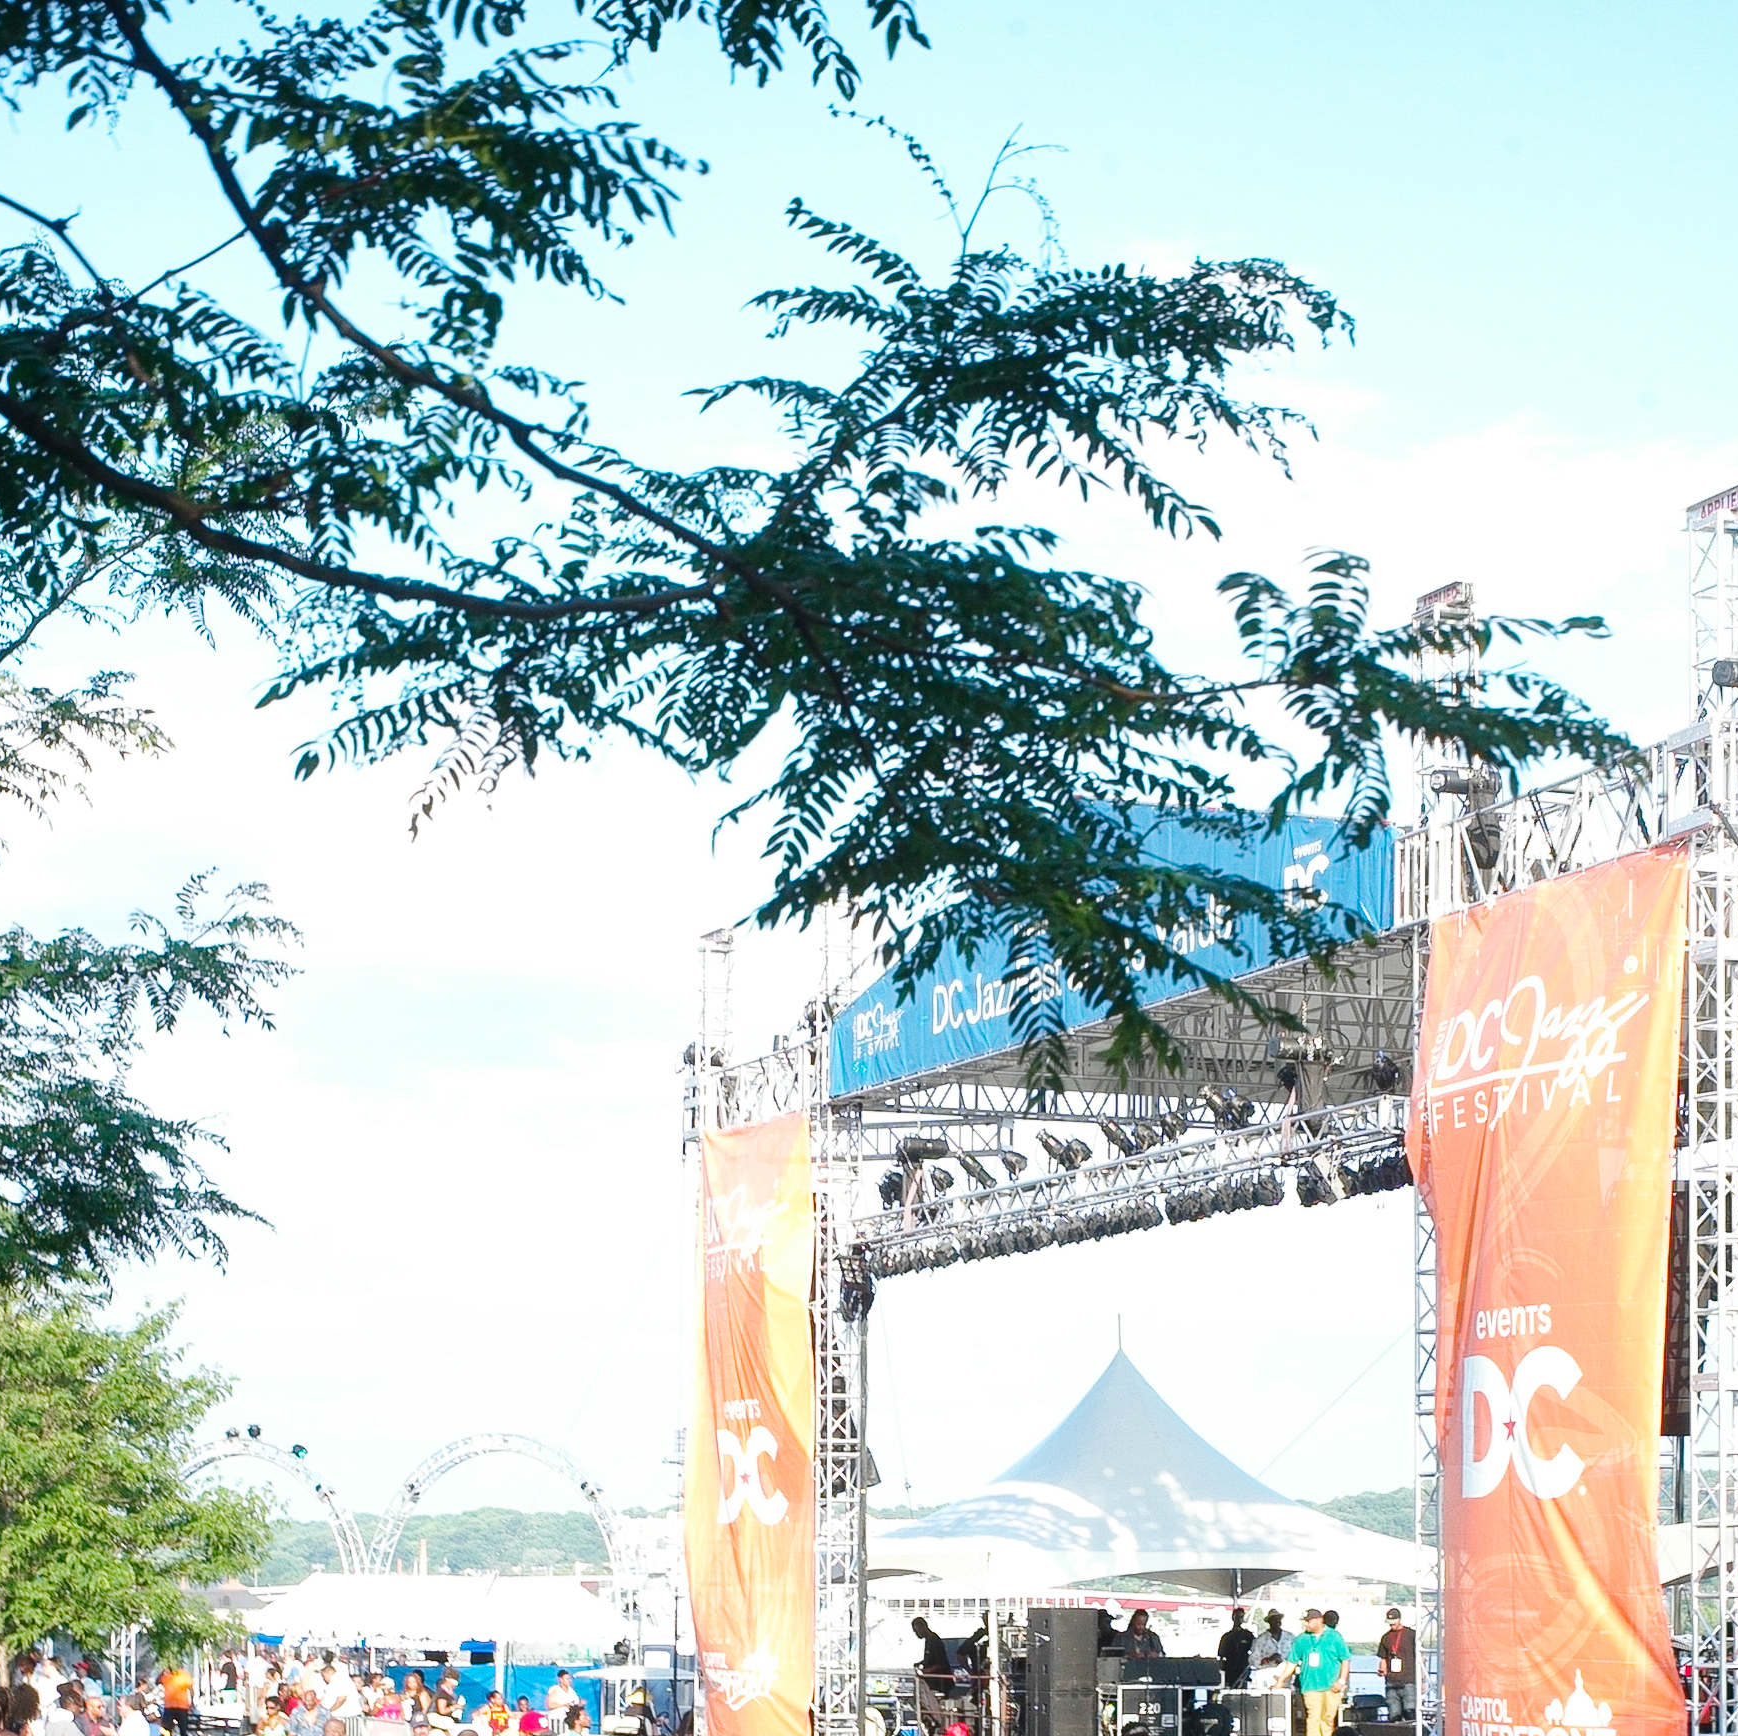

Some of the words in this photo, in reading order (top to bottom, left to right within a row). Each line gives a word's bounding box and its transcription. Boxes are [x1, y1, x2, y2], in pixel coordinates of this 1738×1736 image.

[932, 978, 963, 1034] DC
[1434, 999, 1503, 1081] DC
[1500, 976, 1650, 1122] Jazz
[1430, 1069, 1622, 1133] FESTIVAL
[1462, 1345, 1586, 1500] DC
[716, 1425, 789, 1526] DC
[1138, 1702, 1162, 1715] 220
[1461, 1694, 1513, 1724] CAPITOL
